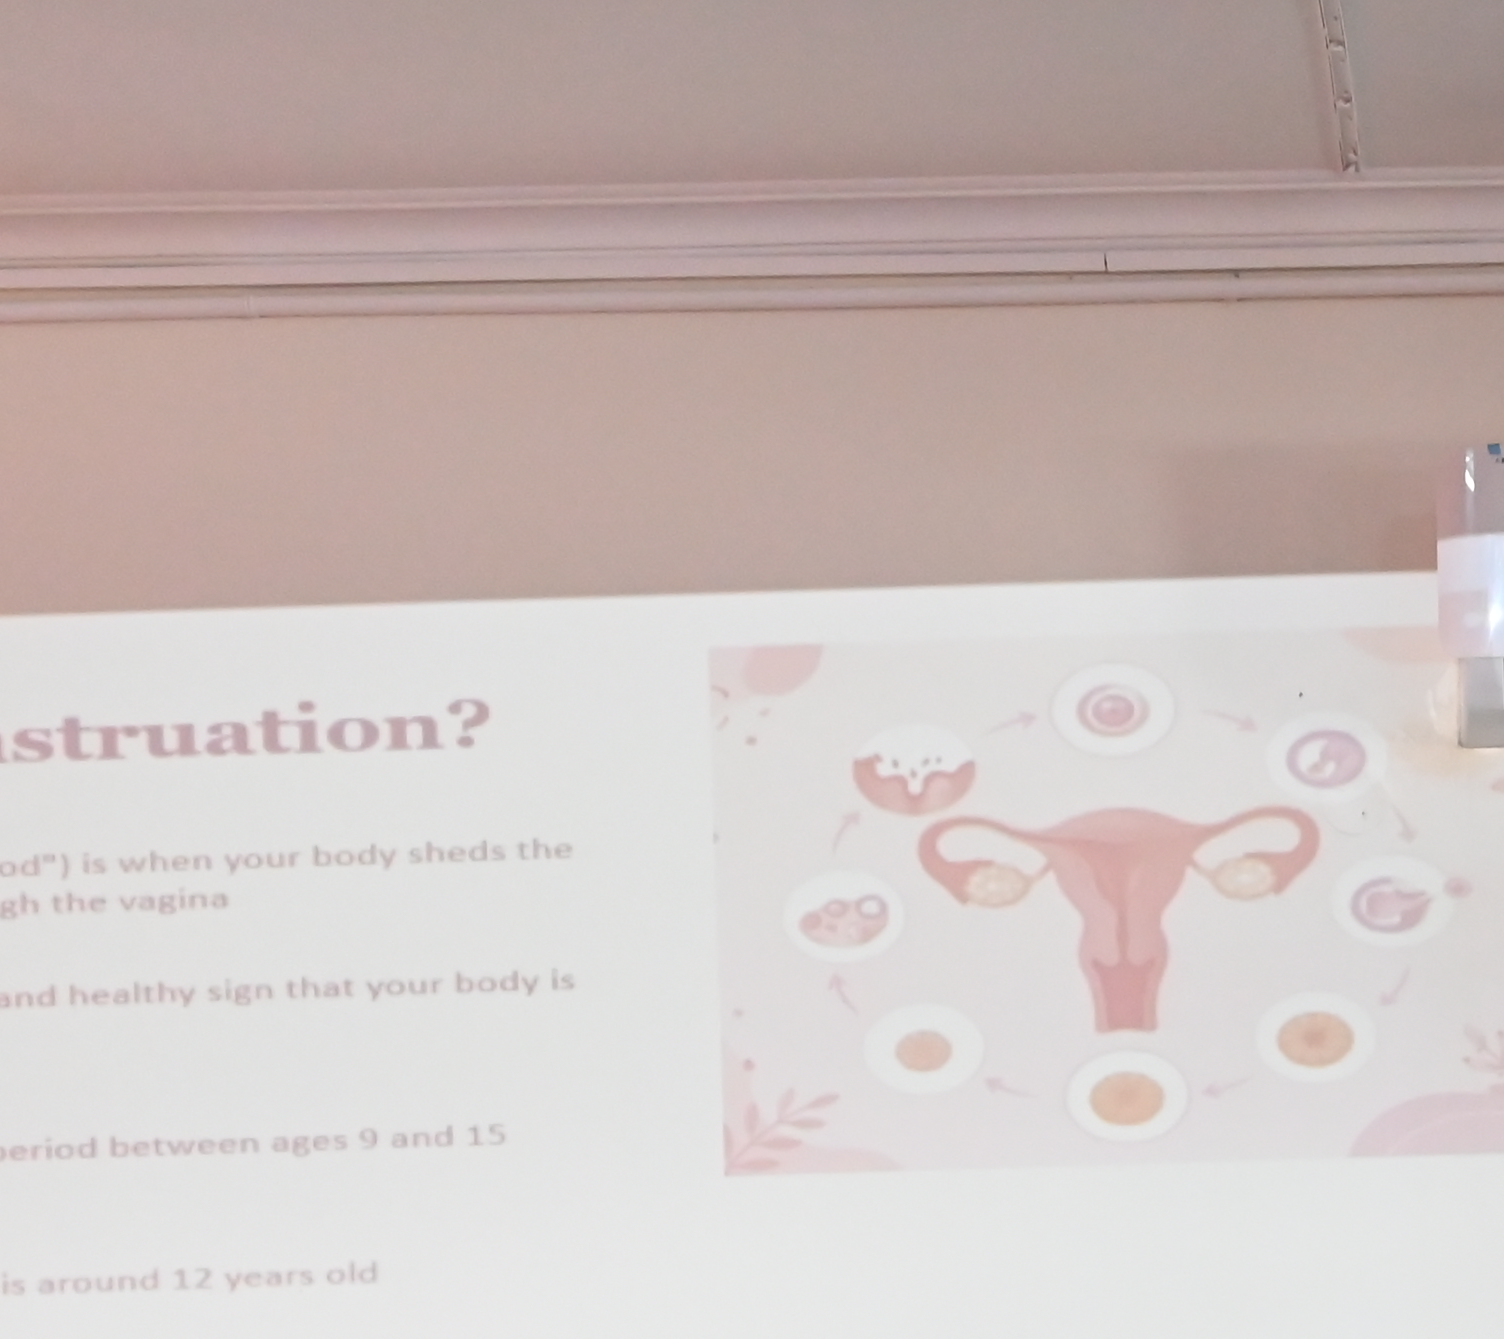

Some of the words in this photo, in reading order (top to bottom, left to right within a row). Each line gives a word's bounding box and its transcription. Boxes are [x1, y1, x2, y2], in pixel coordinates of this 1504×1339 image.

[81, 852, 108, 875] is
[117, 850, 214, 875] when
[223, 851, 300, 875] your
[311, 843, 397, 871] body
[408, 839, 507, 865] sheds
[516, 836, 574, 861] the
[50, 891, 108, 914] the
[118, 889, 230, 916] vagina
[68, 980, 197, 1009] healthy
[207, 979, 275, 1007] sign
[285, 975, 354, 1000] that
[365, 978, 442, 1002] your
[454, 969, 540, 997] body
[550, 968, 576, 992] is
[108, 1135, 261, 1159] between
[270, 1134, 349, 1158] ages
[358, 1128, 380, 1150] 9
[390, 1124, 455, 1150] and
[468, 1122, 507, 1147] 15
[1, 1272, 27, 1297] is
[37, 1268, 161, 1296] around
[173, 1267, 213, 1291] 12
[224, 1269, 315, 1293] years
[325, 1260, 380, 1286] old
